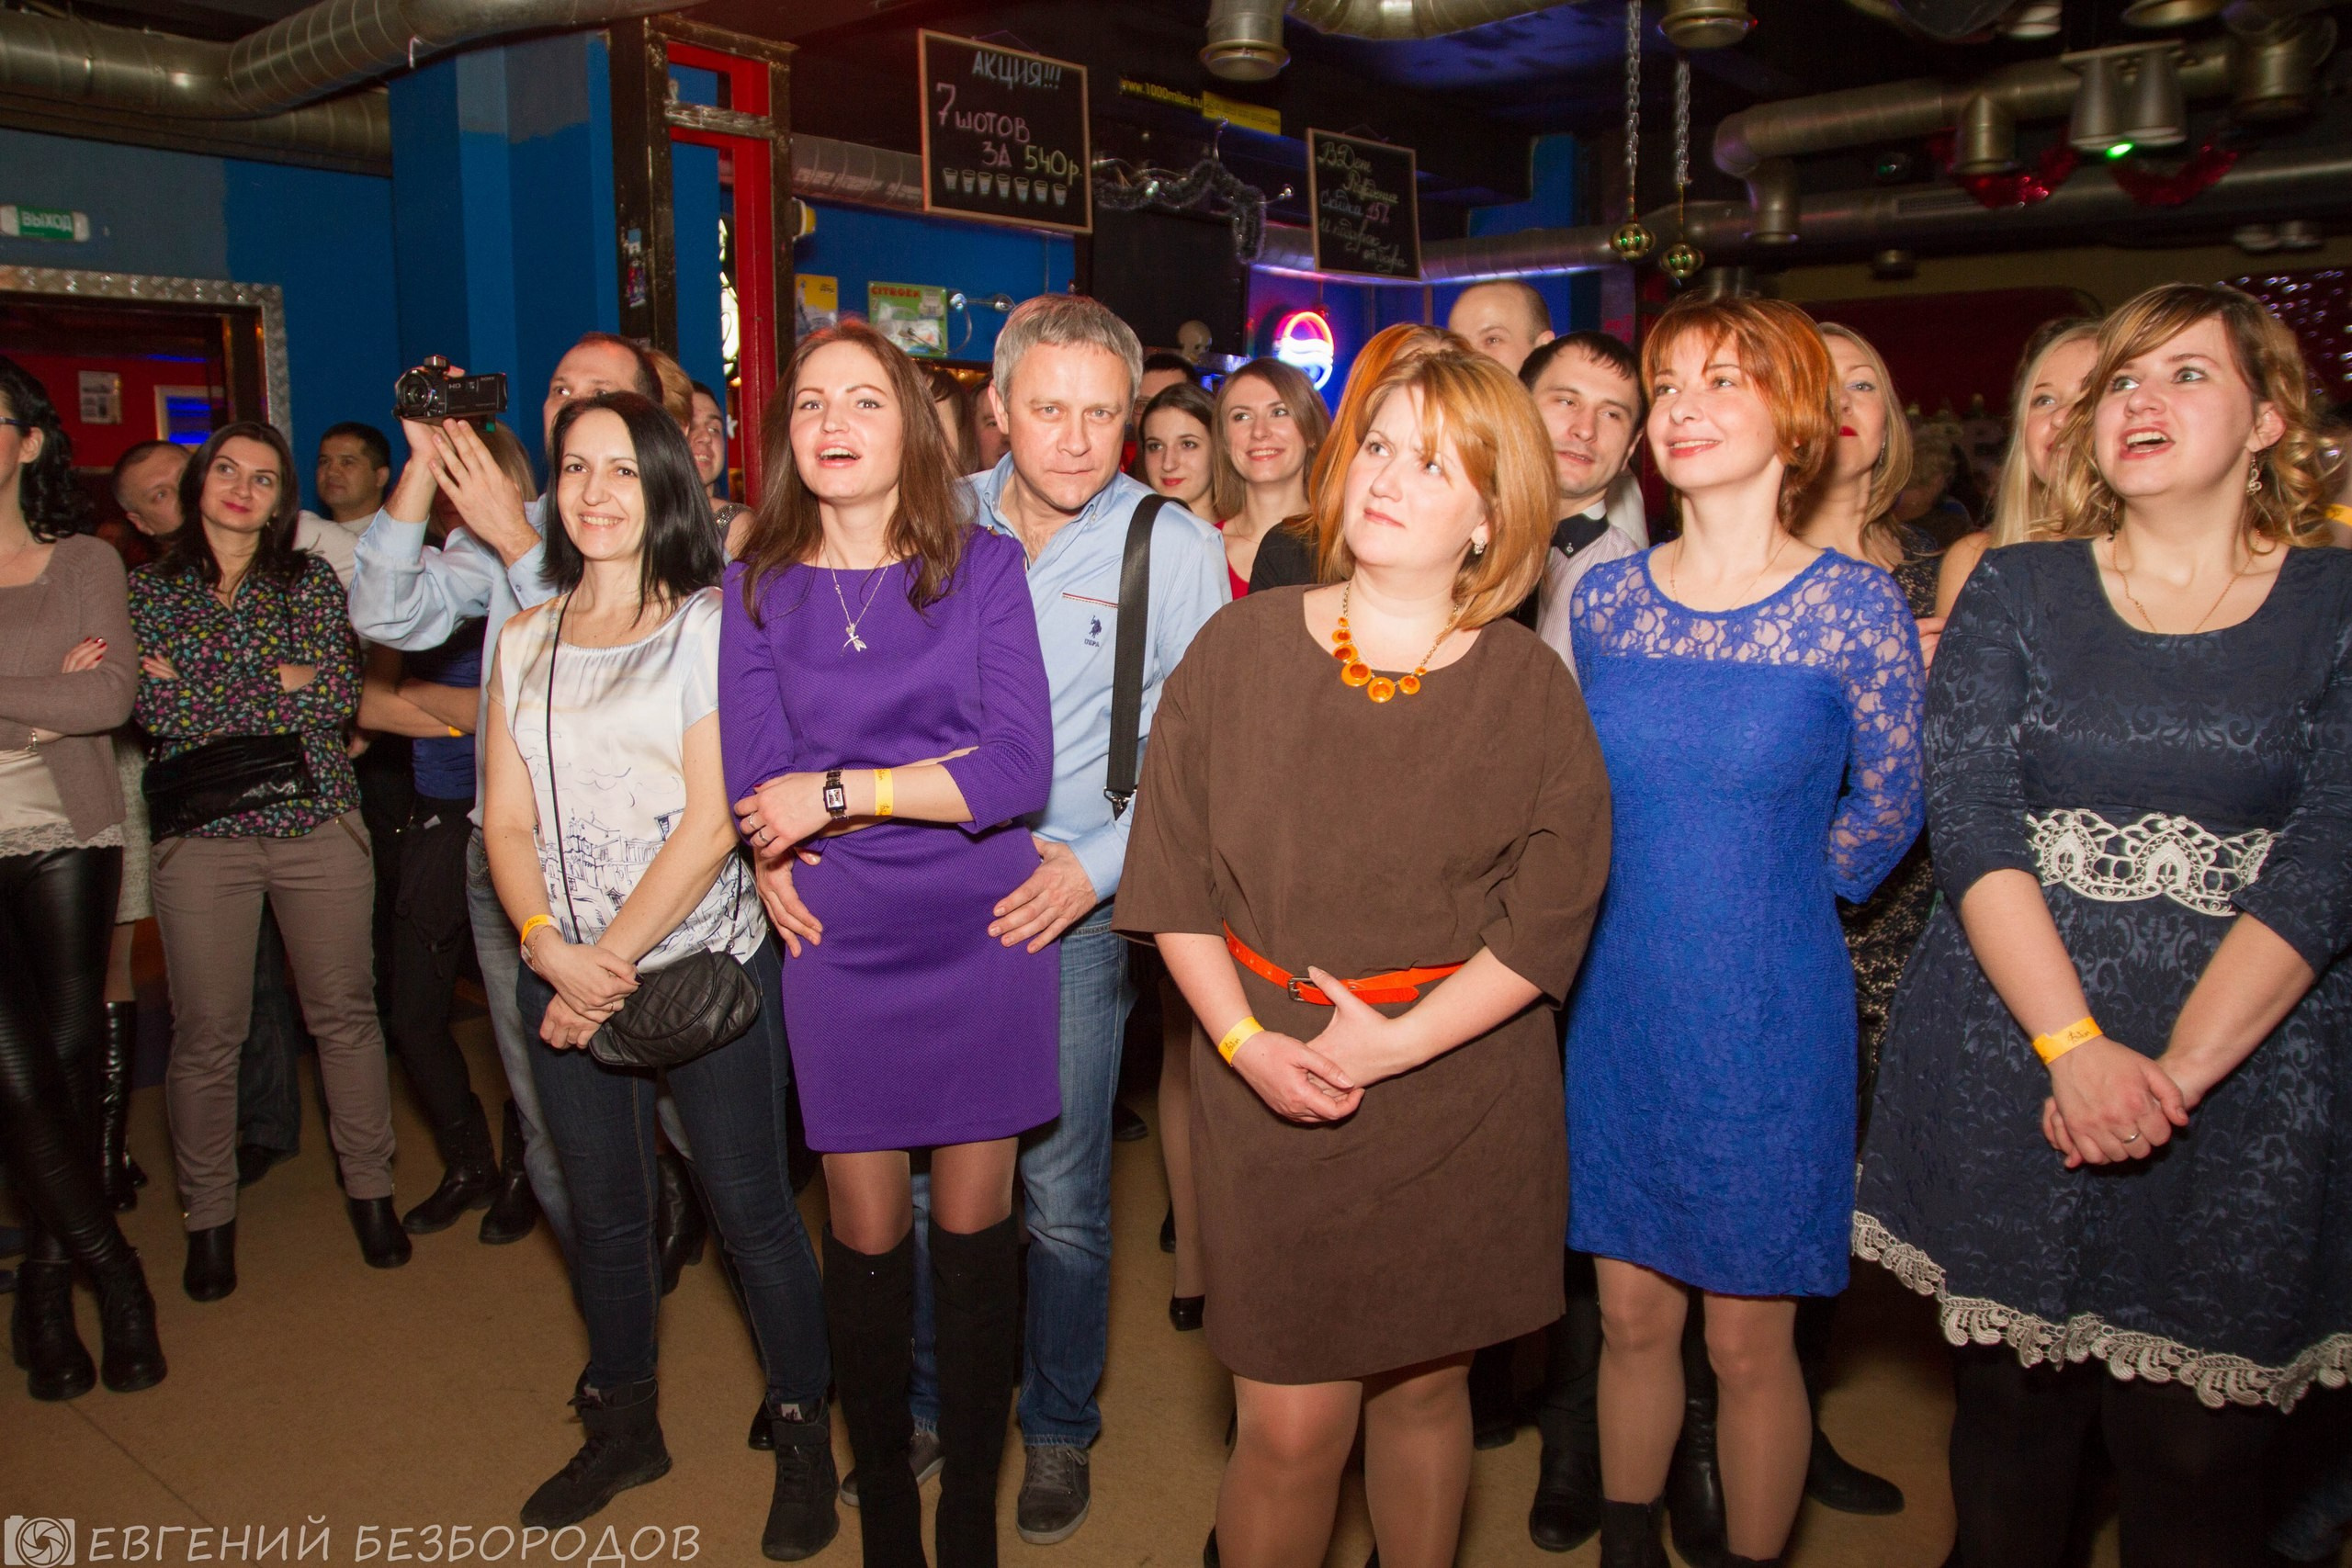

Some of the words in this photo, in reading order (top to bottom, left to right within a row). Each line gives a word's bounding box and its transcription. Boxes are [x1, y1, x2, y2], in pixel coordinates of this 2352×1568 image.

[971, 51, 1062, 90] АКЦИЯ!!!
[935, 82, 956, 126] 7
[981, 141, 1012, 168] ЗА
[21, 210, 73, 232] ВЫХОД
